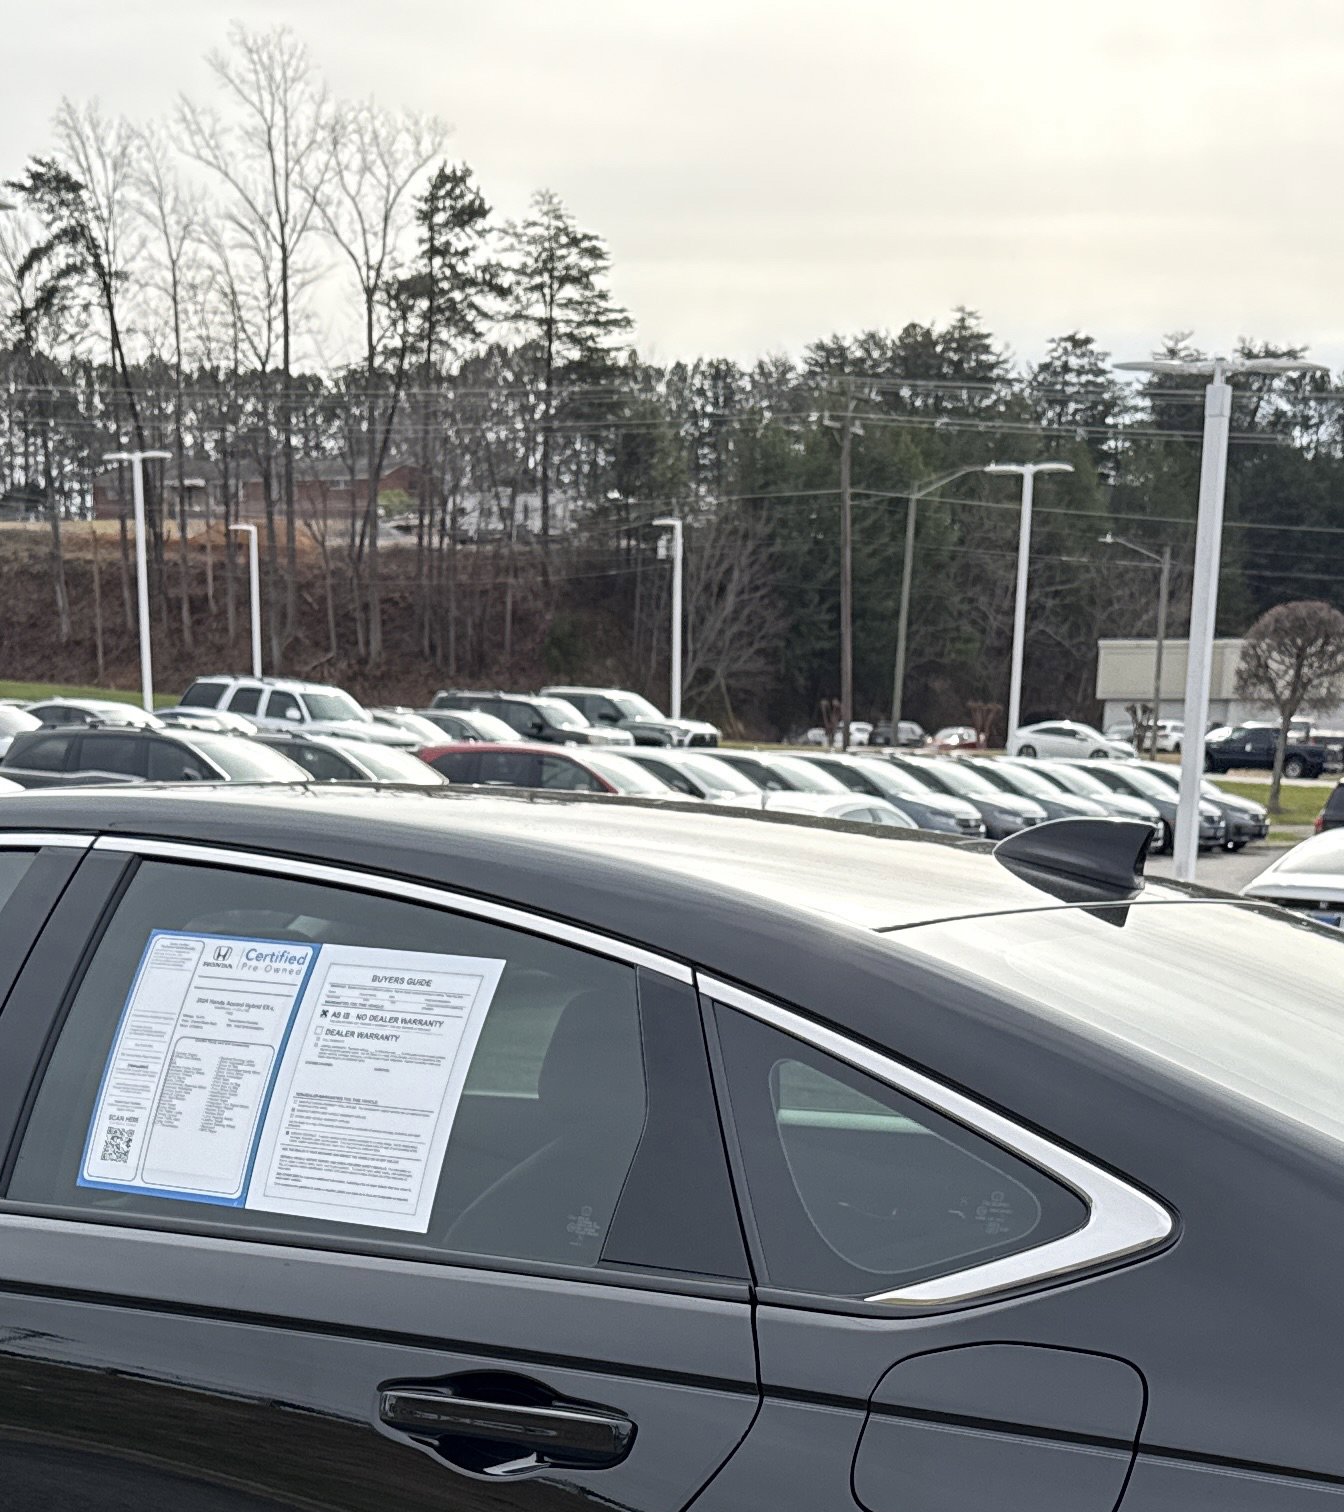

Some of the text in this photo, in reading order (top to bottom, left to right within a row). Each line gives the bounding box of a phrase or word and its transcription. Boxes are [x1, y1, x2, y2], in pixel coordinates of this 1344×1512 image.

[245, 948, 308, 966] Certified
[241, 963, 302, 976] Pre Owned
[372, 975, 433, 987] BUYERS GUIDE
[369, 1014, 399, 1024] DEALER
[400, 1017, 444, 1028] WARRANTY
[325, 1028, 355, 1039] DEALER
[356, 1031, 400, 1042] WARRANTY
